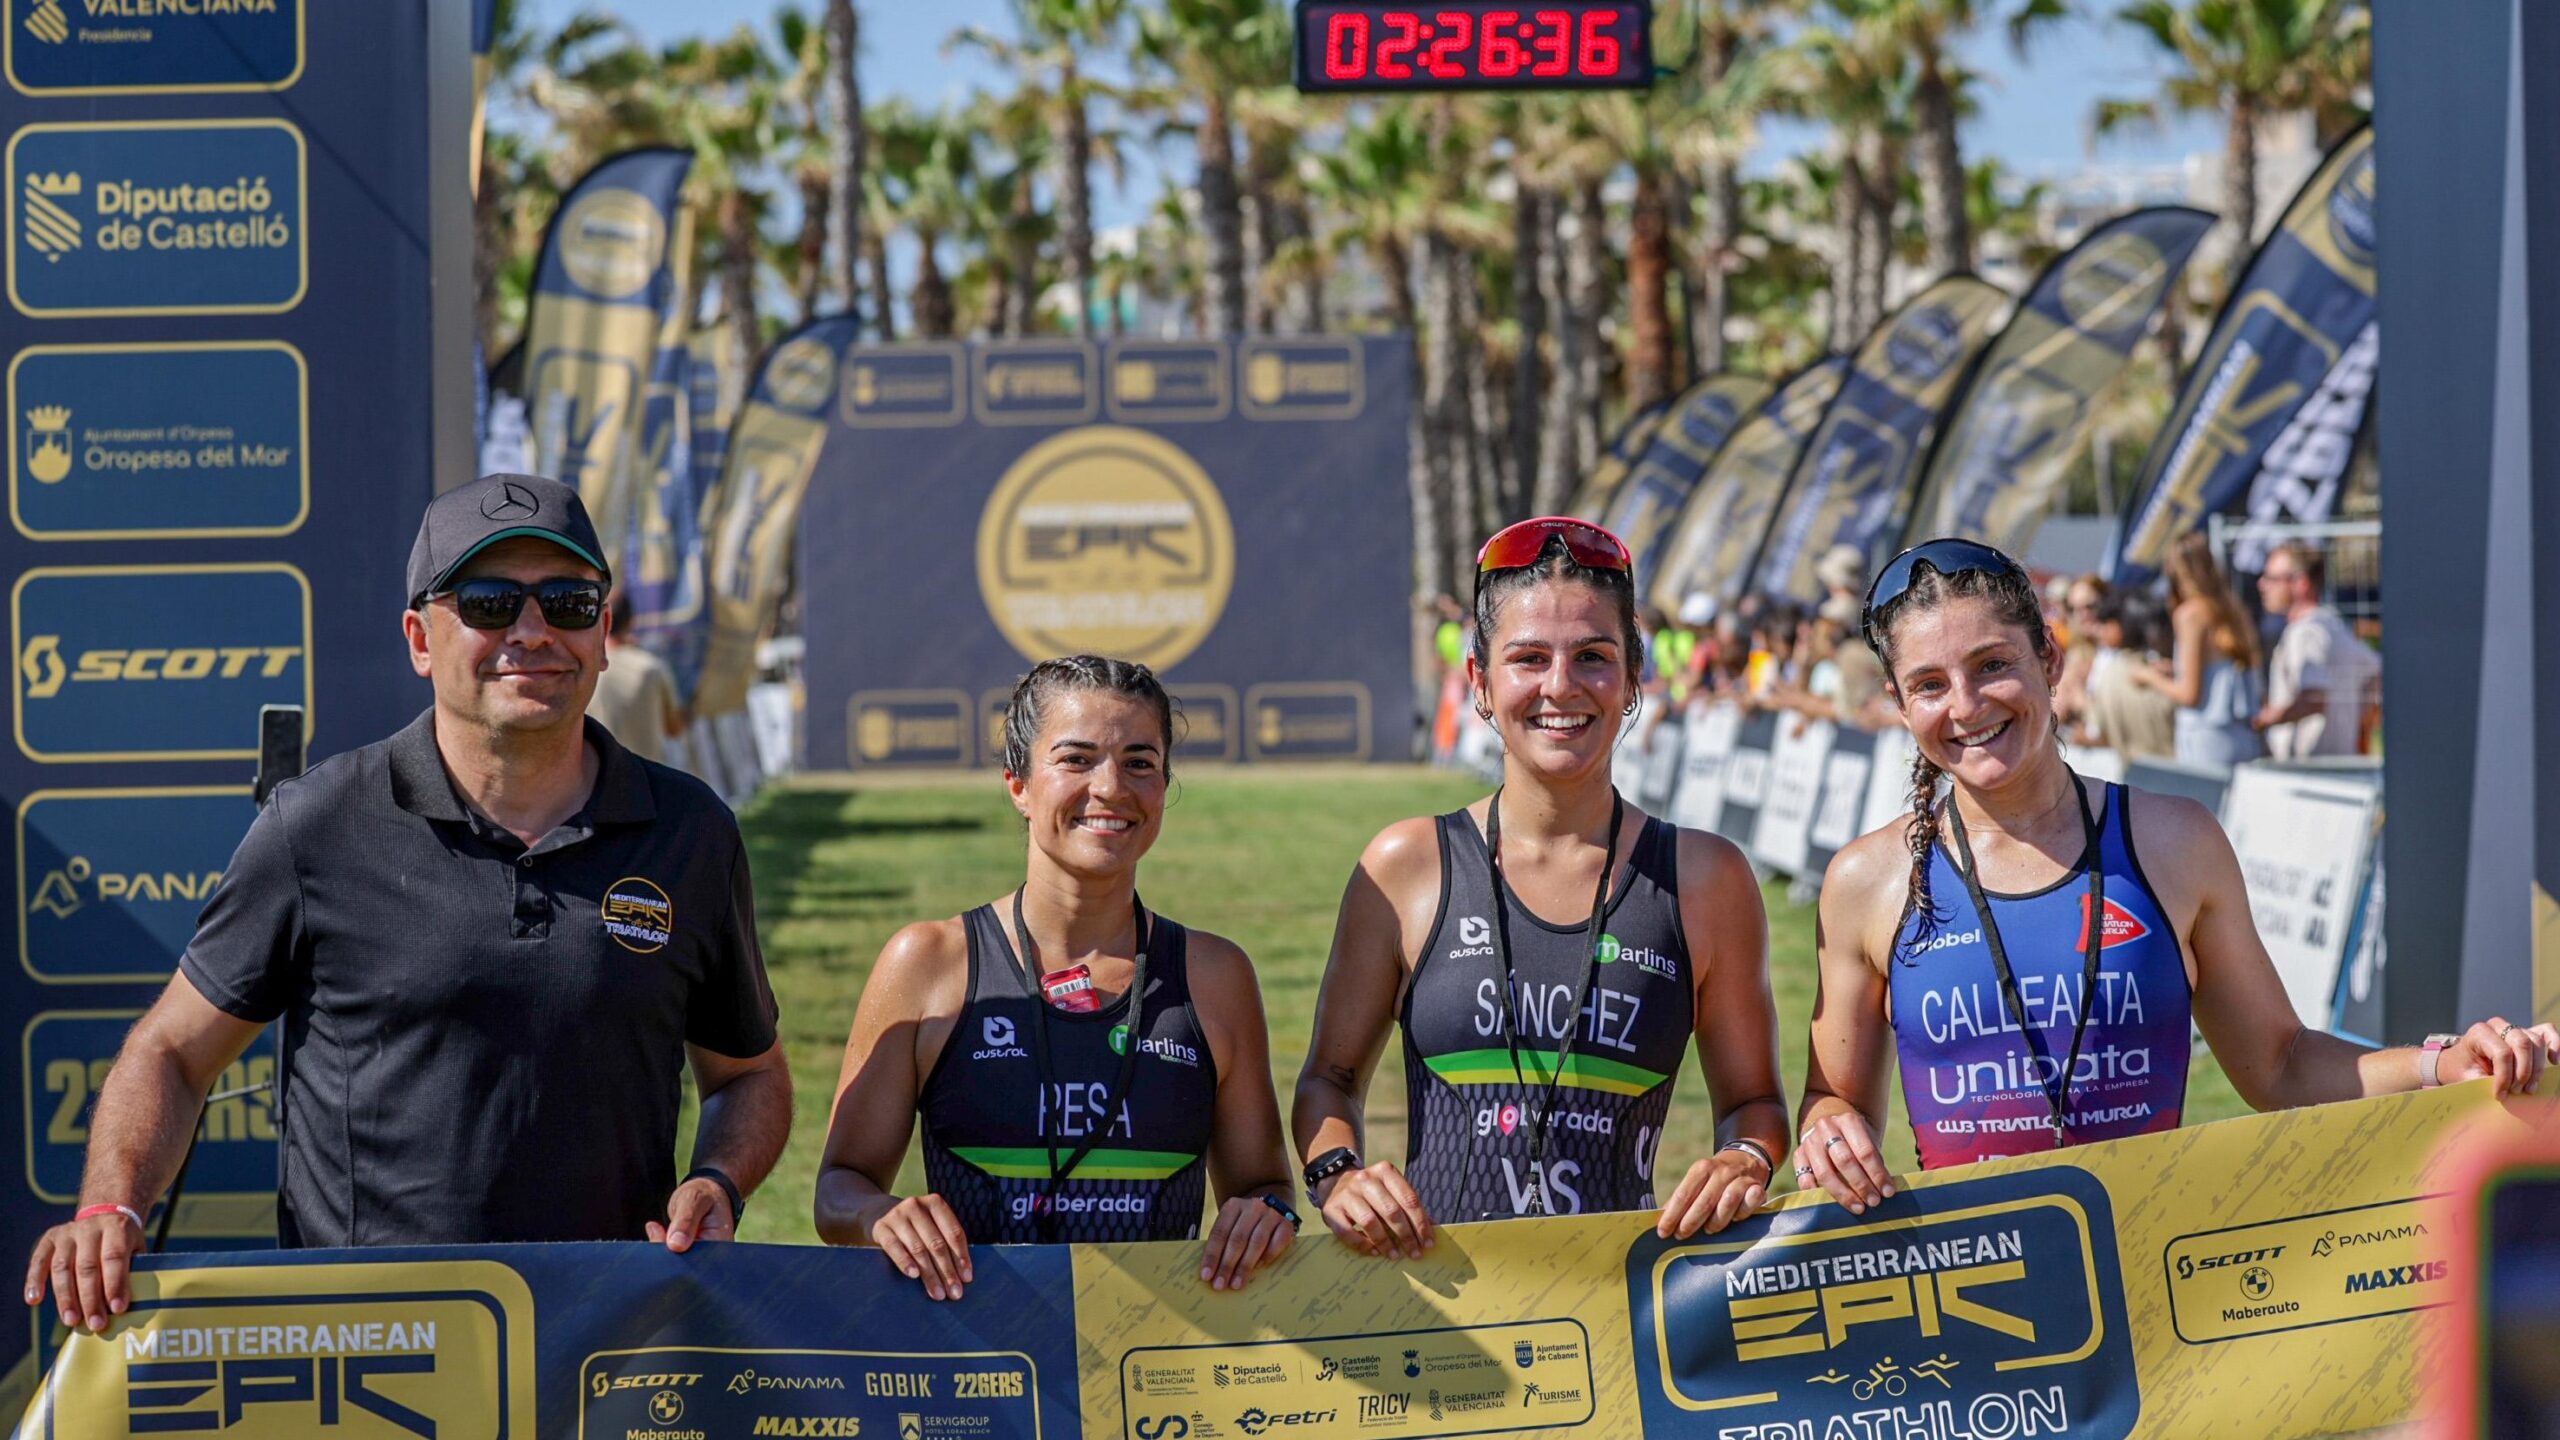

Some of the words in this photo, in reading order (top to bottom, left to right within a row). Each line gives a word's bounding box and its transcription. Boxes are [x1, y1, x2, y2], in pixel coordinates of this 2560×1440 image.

[1325, 9, 1621, 80] 02:26:36
[97, 177, 272, 219] Diputació
[97, 219, 142, 250] de
[147, 213, 289, 249] Castelló
[84, 445, 191, 473] Oropesa
[196, 445, 235, 468] del
[240, 443, 290, 468] Mar
[71, 646, 302, 681] SCOTT
[98, 871, 225, 901] PANA
[1474, 968, 1641, 1054] SÁNCHEZ
[1921, 971, 2144, 1044] CALLEALTA
[972, 1047, 1028, 1060] austral
[1970, 1089, 2044, 1103] TECNOLOGÍA
[2086, 1084, 2100, 1093] LA
[2104, 1078, 2150, 1092] EMPRESA
[1038, 1082, 1132, 1139] RESA
[1012, 1193, 1146, 1220] glberada
[2339, 1223, 2428, 1248] PANAMA
[1725, 1229, 2024, 1298] MEDITERRANEAN
[2197, 1246, 2286, 1271] SCOTT
[2344, 1260, 2449, 1294] MAXXIS
[2222, 1301, 2300, 1322] Maberauto
[125, 1321, 437, 1360] MEDITERRANEAN
[1145, 1368, 1195, 1377] GENERALITAT
[1233, 1363, 1281, 1376] Diputació
[1234, 1376, 1247, 1385] de
[1248, 1372, 1288, 1384] Castelló
[1425, 1362, 1466, 1372] Oropesa
[1467, 1360, 1482, 1369] del
[611, 1373, 703, 1389] SCOTT
[757, 1377, 845, 1389] PANAMA
[865, 1372, 933, 1397] GOBIK
[954, 1372, 1024, 1398] 226ERS
[1146, 1376, 1195, 1384] VALENCIANA
[1358, 1392, 1411, 1422] TRICV
[1444, 1391, 1505, 1404] GENERALITAT
[1445, 1401, 1506, 1413] VALENCIANA
[1538, 1389, 1581, 1401] TURISME
[924, 1416, 990, 1427] SERVIGROUP
[1719, 1385, 2070, 1440] ATHLON
[626, 1428, 705, 1440] Maberauto
[753, 1416, 860, 1438] MAXXIS
